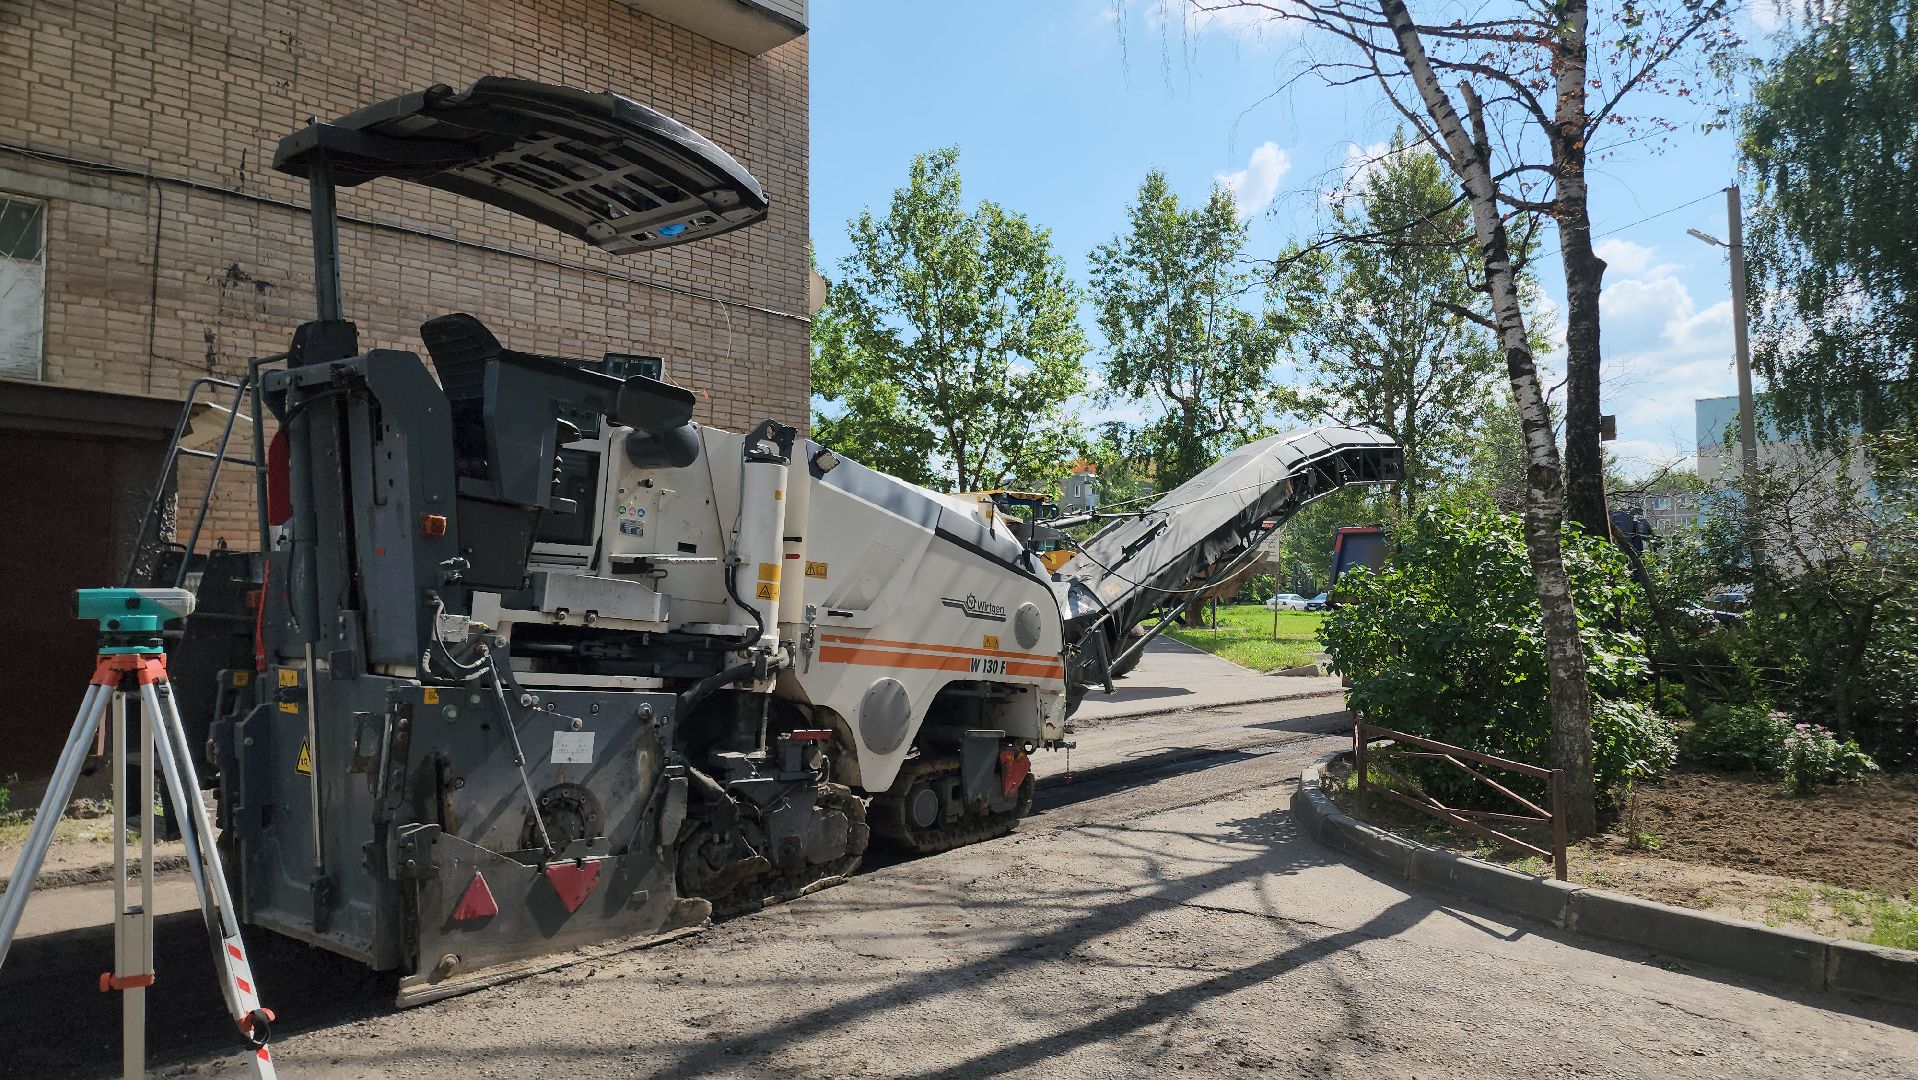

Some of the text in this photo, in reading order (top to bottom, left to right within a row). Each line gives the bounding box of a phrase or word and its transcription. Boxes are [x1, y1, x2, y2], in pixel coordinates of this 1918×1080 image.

[977, 600, 1005, 615] Wirtgen
[971, 658, 1006, 674] W 130 F
